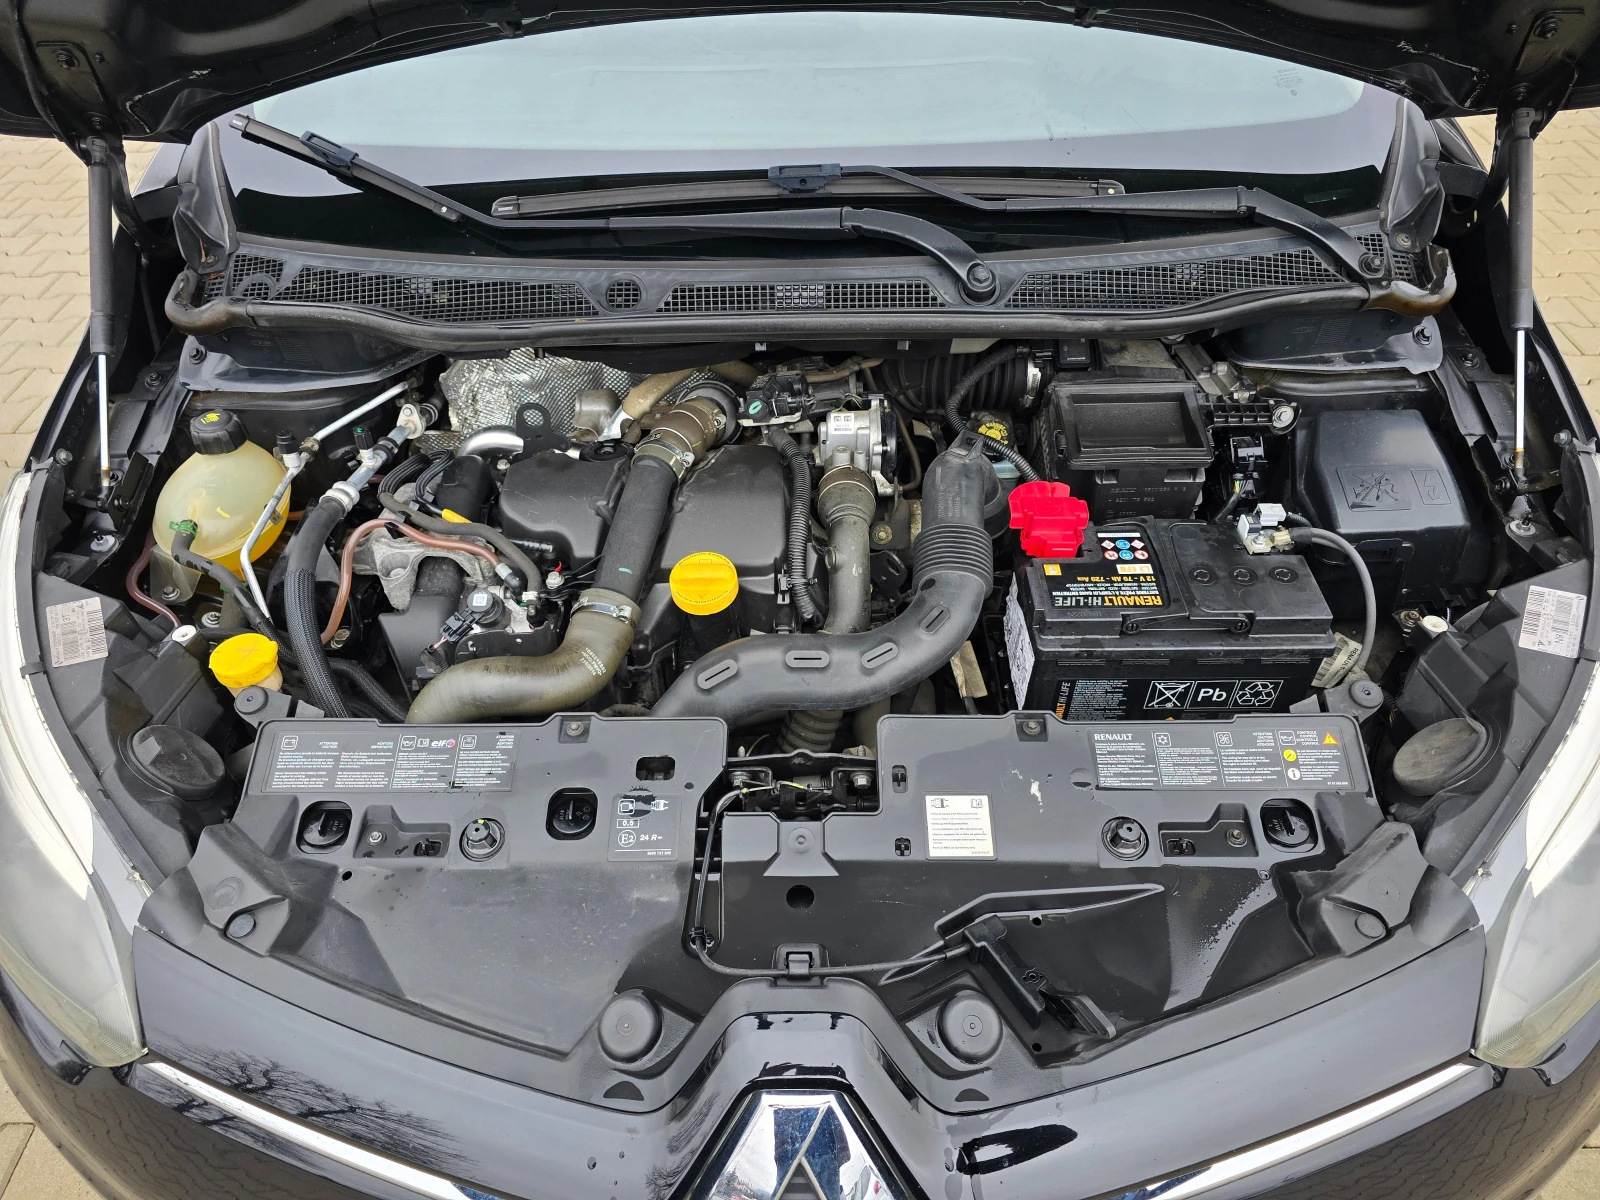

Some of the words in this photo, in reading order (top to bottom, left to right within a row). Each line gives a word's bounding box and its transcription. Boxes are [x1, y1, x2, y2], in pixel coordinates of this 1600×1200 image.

[1054, 597, 1101, 606] Hi-LIFE
[1104, 596, 1162, 606] RENAULT
[1197, 688, 1227, 702] Pb
[621, 834, 634, 844] E2
